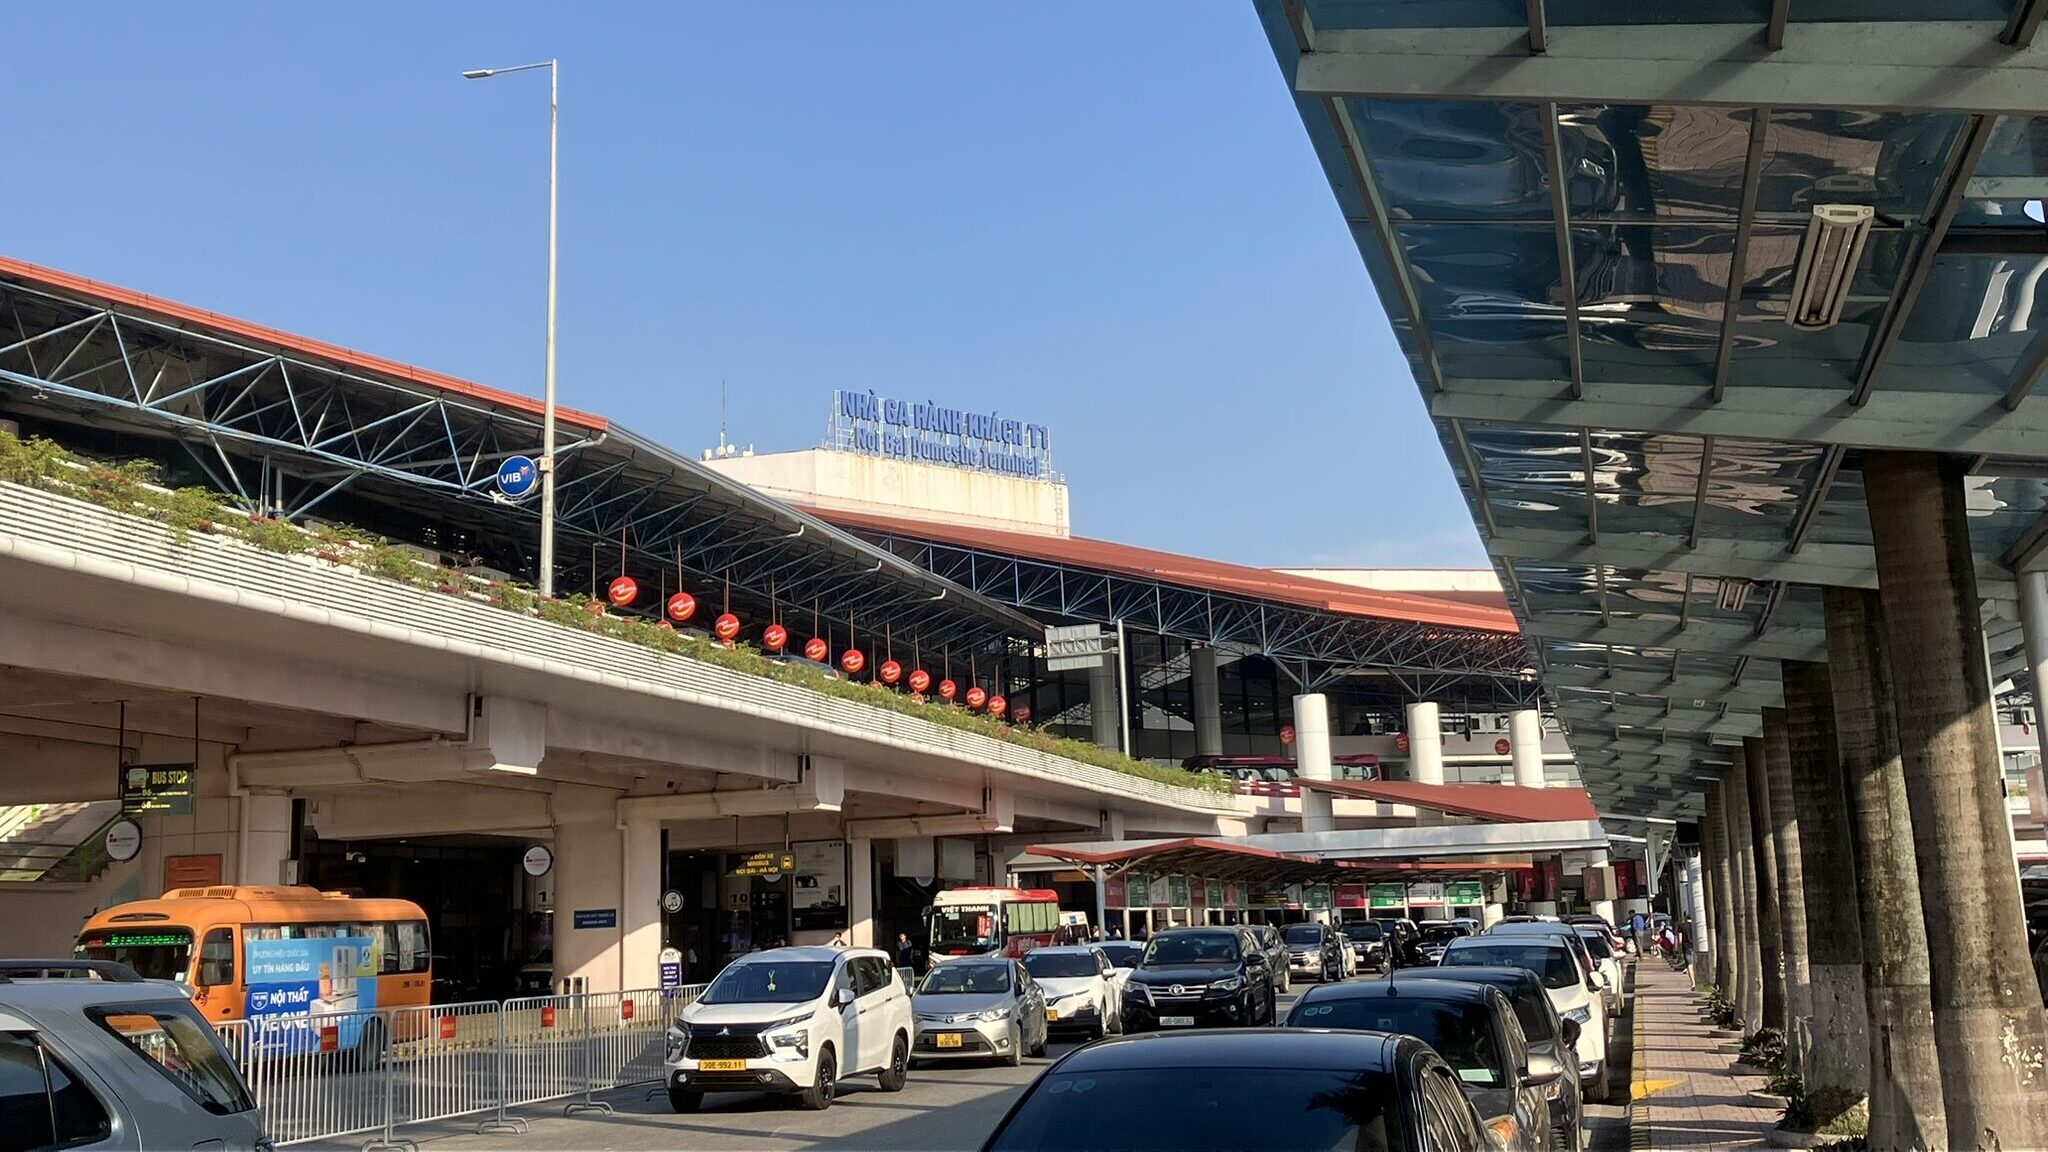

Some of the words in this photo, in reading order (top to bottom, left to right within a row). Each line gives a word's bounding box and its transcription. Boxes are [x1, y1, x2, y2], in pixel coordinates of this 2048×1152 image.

[840, 388, 880, 423] NHÀ
[884, 399, 909, 428] GA
[913, 399, 962, 436] HÀNH
[966, 411, 1023, 446] KHÁCH
[1026, 423, 1048, 450] T1
[910, 436, 977, 467] Domestic
[980, 447, 1039, 477] Terminal
[500, 472, 522, 485] VIB
[152, 771, 167, 785] BUS
[168, 770, 188, 784] STOP
[730, 893, 748, 903] 10
[941, 905, 960, 913] VIỆT
[961, 905, 990, 913] THANH
[269, 988, 287, 1008] NỘI
[287, 986, 310, 1004] THẤT
